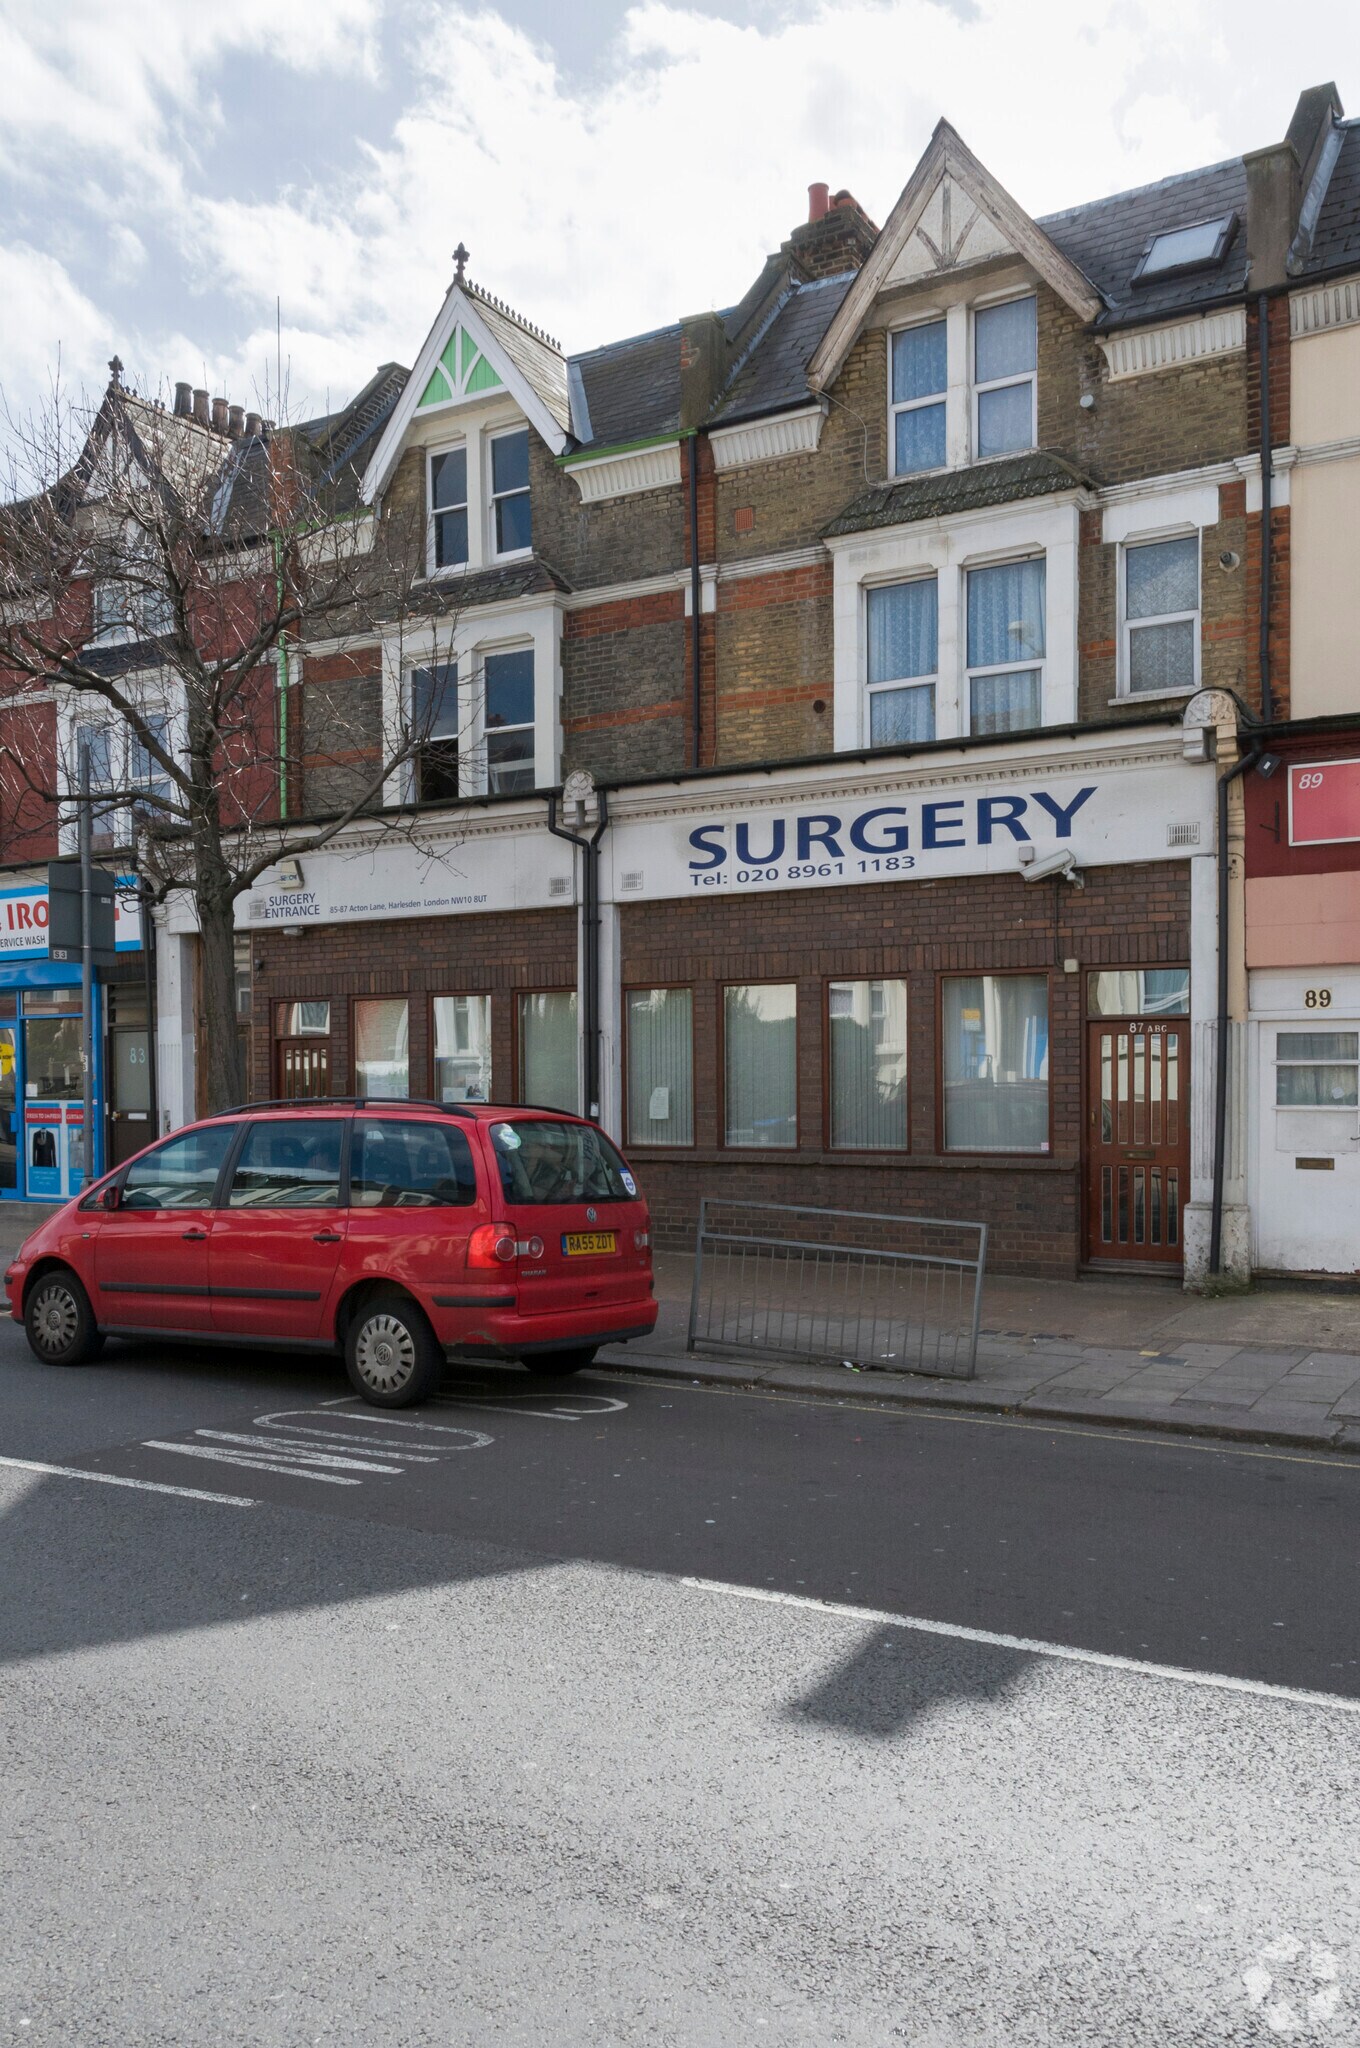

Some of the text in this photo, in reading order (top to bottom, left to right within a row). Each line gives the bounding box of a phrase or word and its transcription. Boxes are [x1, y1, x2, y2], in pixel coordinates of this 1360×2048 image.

[1299, 772, 1324, 790] 89
[689, 786, 1099, 870] SURGERY
[690, 856, 915, 887] Tel: 020 8961 1183
[269, 893, 316, 907] SURGERY
[330, 895, 487, 914] 85-87 Acton Lane, Harlesden London NW10 8UT
[7, 900, 49, 930] IRO
[265, 904, 320, 919] ENTRANCE
[0, 935, 46, 948] ERVICE WASH
[1304, 989, 1332, 1009] 89
[1129, 1022, 1144, 1034] 87
[130, 1047, 146, 1064] 83
[569, 1235, 594, 1251] RA55
